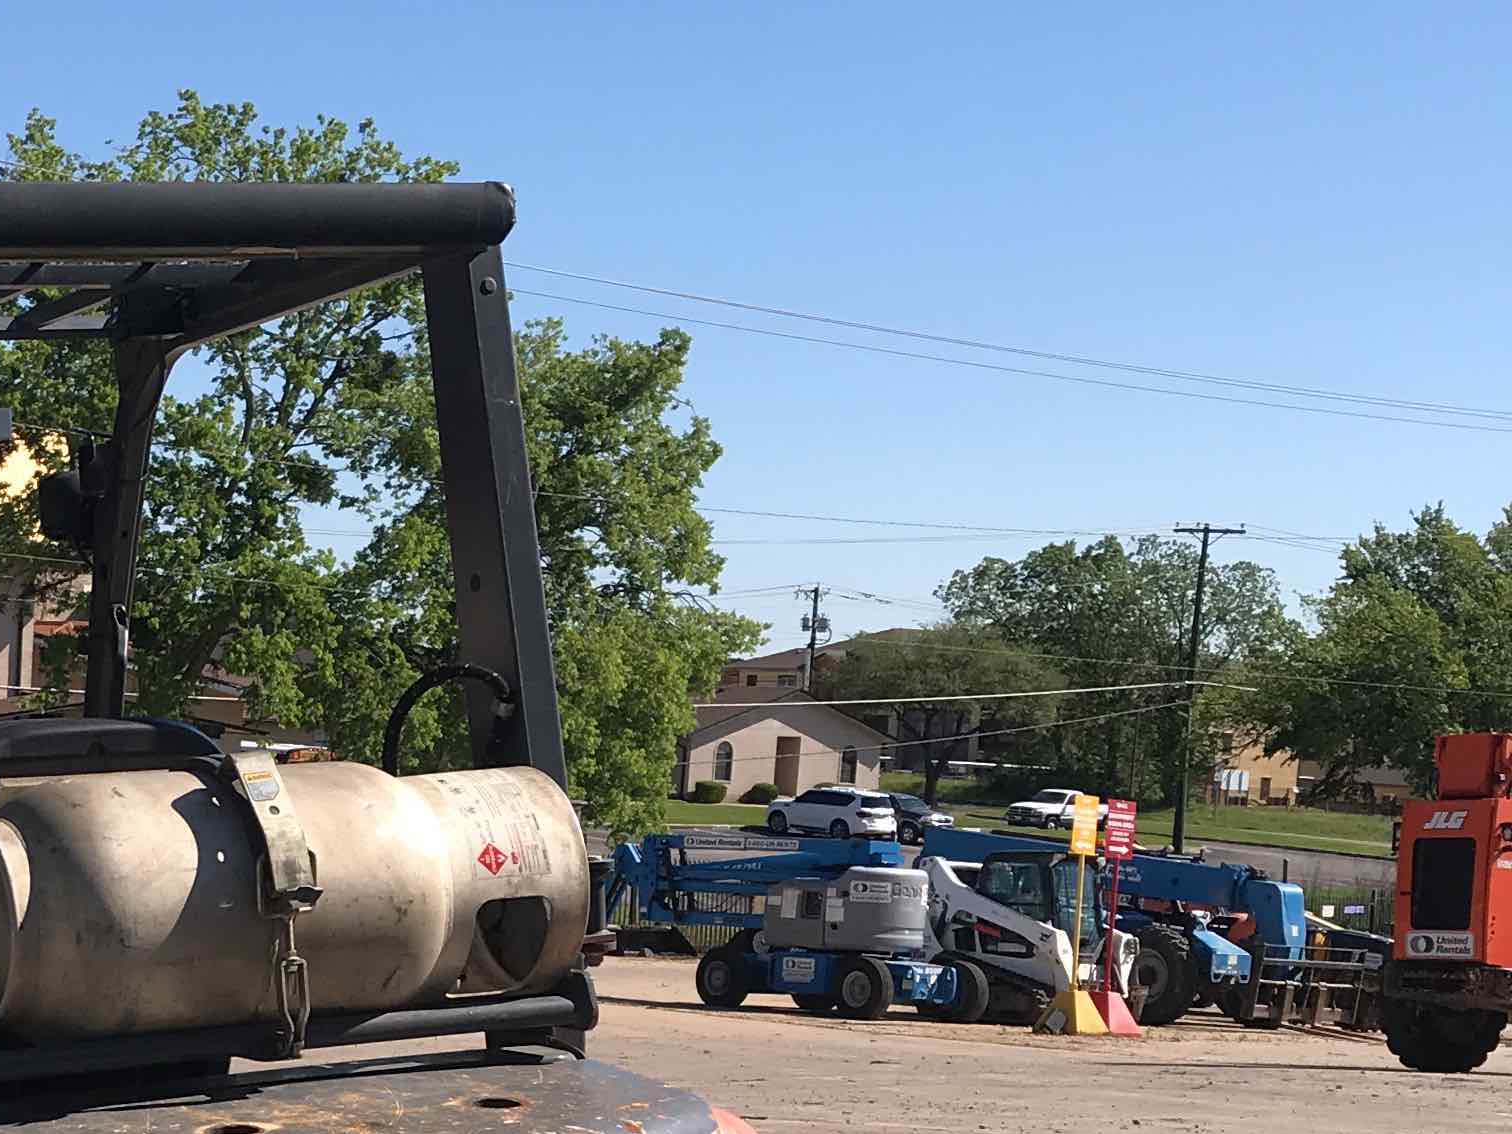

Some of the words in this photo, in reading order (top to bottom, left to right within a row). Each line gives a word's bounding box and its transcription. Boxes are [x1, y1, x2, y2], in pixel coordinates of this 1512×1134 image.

[1423, 810, 1468, 830] JLG
[1435, 935, 1469, 945] United
[1434, 944, 1471, 955] Rentals
